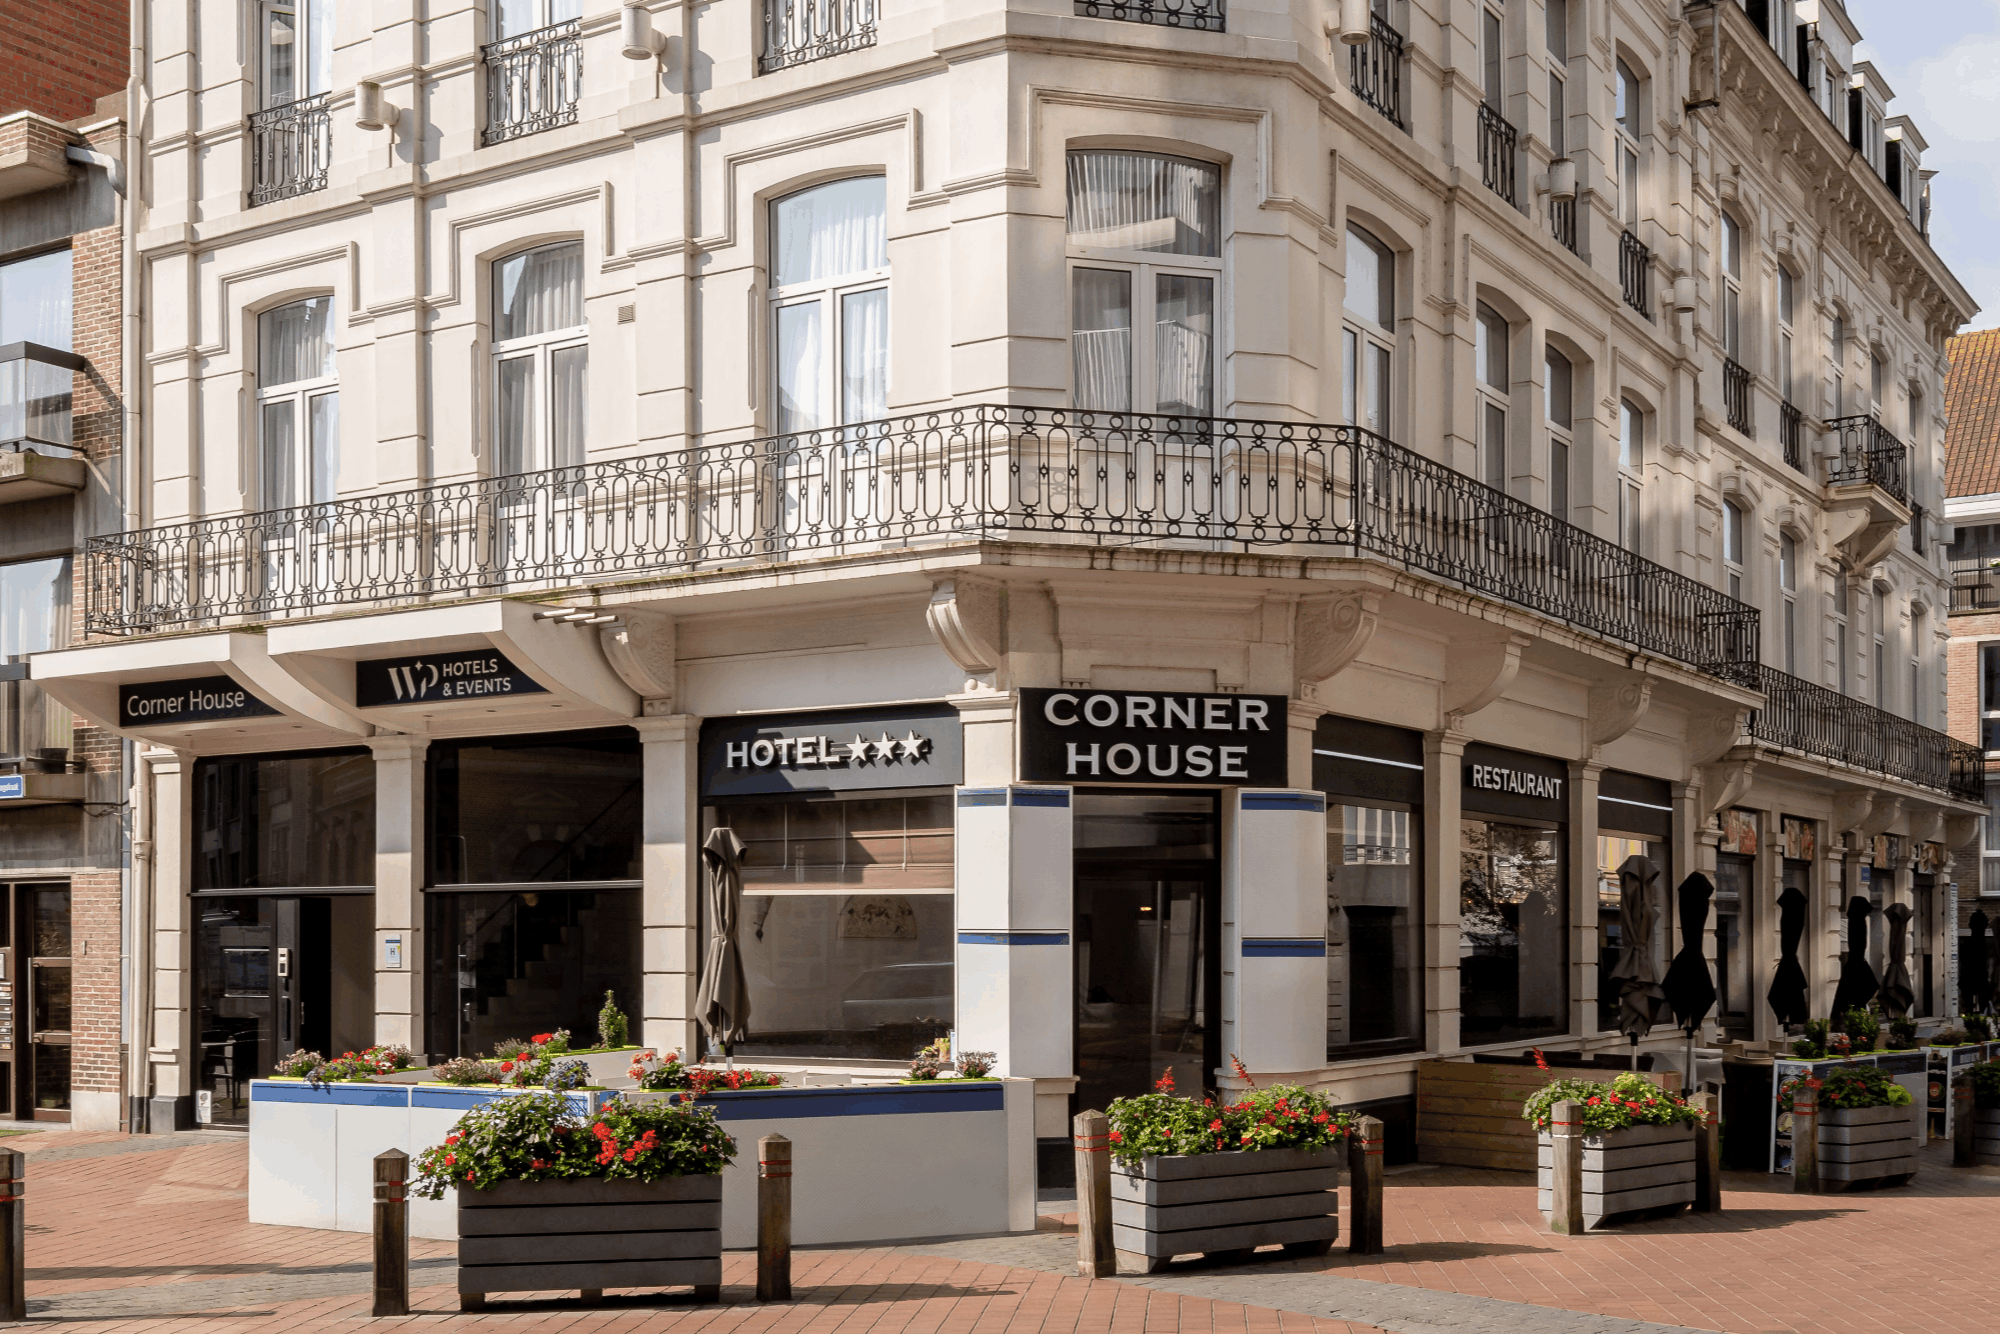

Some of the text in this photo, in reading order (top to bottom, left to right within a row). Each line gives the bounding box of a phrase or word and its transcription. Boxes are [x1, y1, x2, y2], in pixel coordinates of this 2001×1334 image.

[443, 659, 499, 677] HOTELS
[127, 689, 245, 717] Corner House
[442, 677, 511, 697] & EVENTS
[1044, 693, 1270, 731] CORNER
[726, 735, 841, 768] HOTEL
[1066, 742, 1249, 779] HOUSE
[1472, 763, 1562, 800] RESTAURANT
